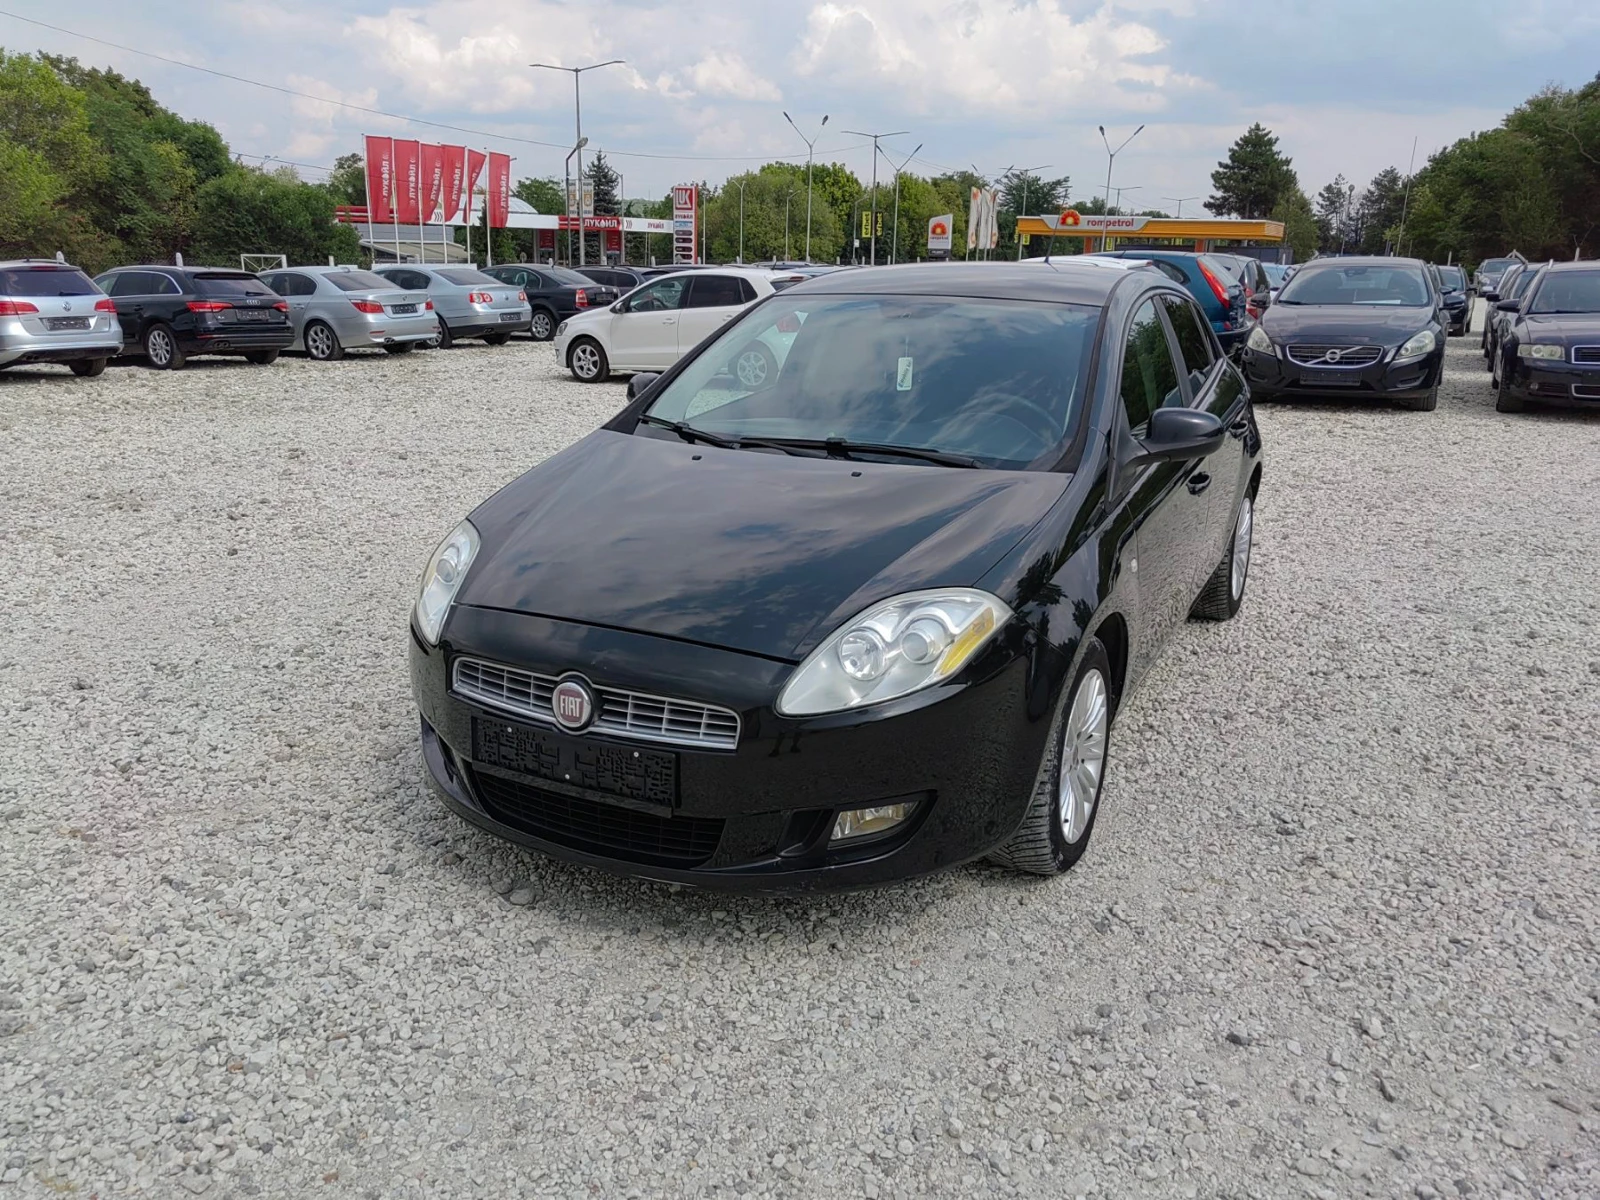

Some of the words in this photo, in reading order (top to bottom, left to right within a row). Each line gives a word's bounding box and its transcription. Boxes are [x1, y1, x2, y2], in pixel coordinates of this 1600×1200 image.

[583, 218, 618, 228] ЛУКОЙЛ
[1087, 218, 1134, 228] rompetrol
[560, 694, 582, 717] FIAT
